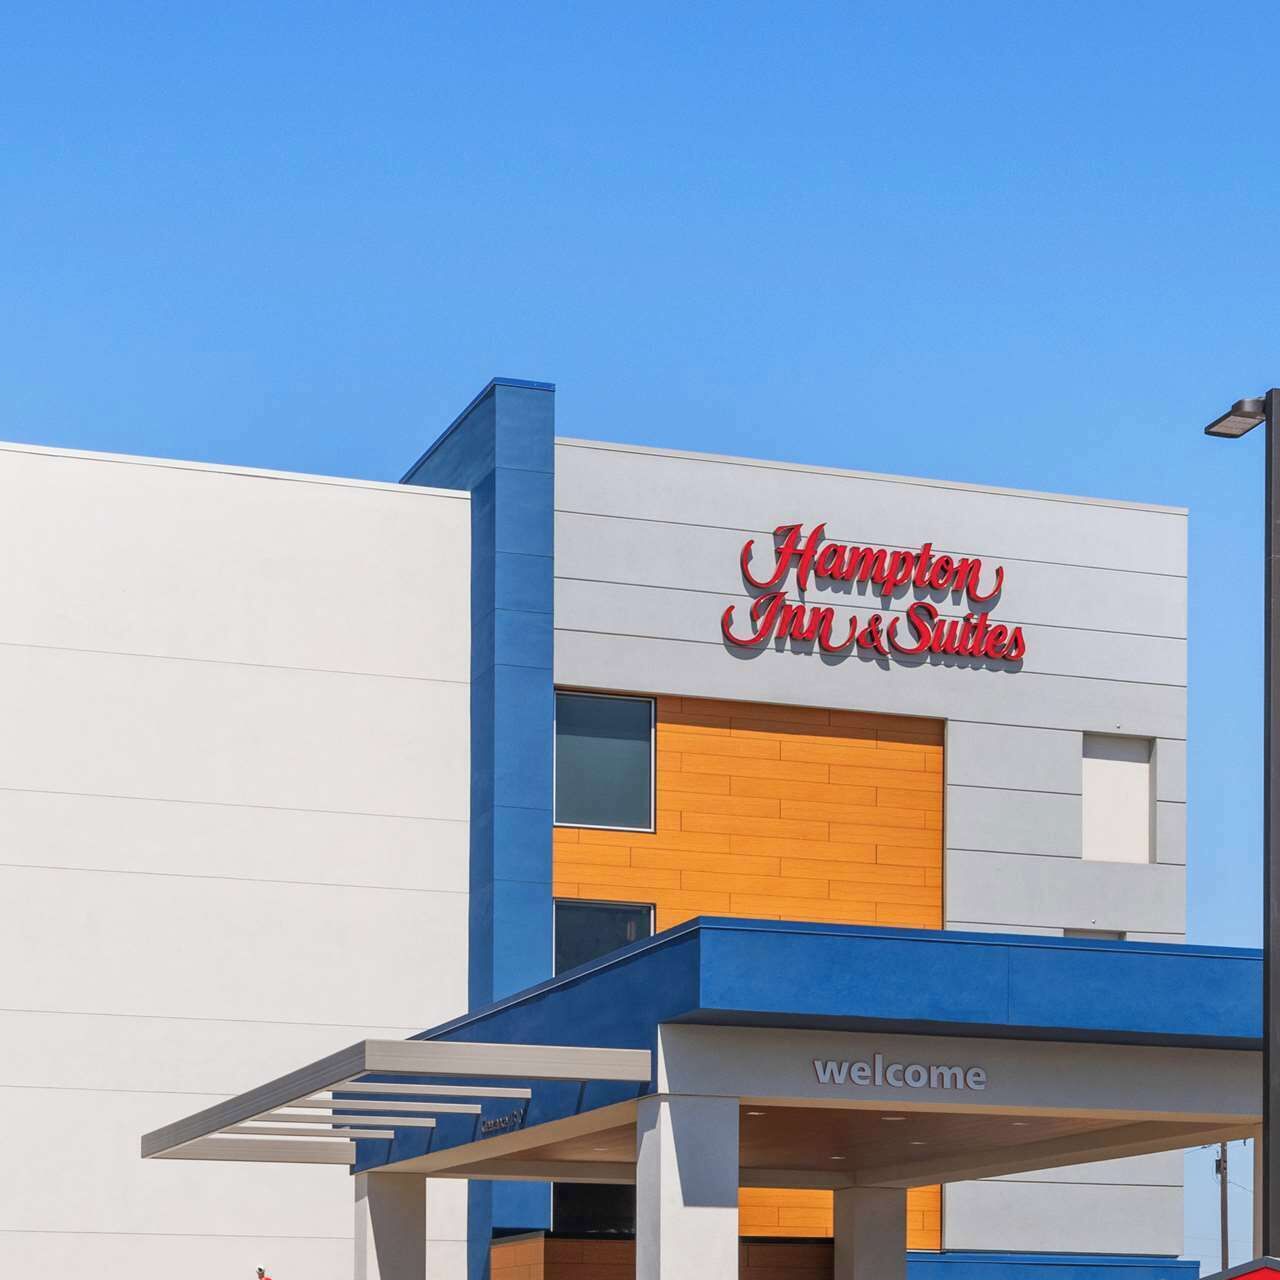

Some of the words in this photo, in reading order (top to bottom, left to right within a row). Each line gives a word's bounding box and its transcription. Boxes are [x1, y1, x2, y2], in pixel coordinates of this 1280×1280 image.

[740, 522, 1004, 602] Hampton
[721, 591, 857, 653] Inn
[856, 613, 890, 656] &
[887, 601, 1026, 661] Suites
[813, 1053, 988, 1090] welcome
